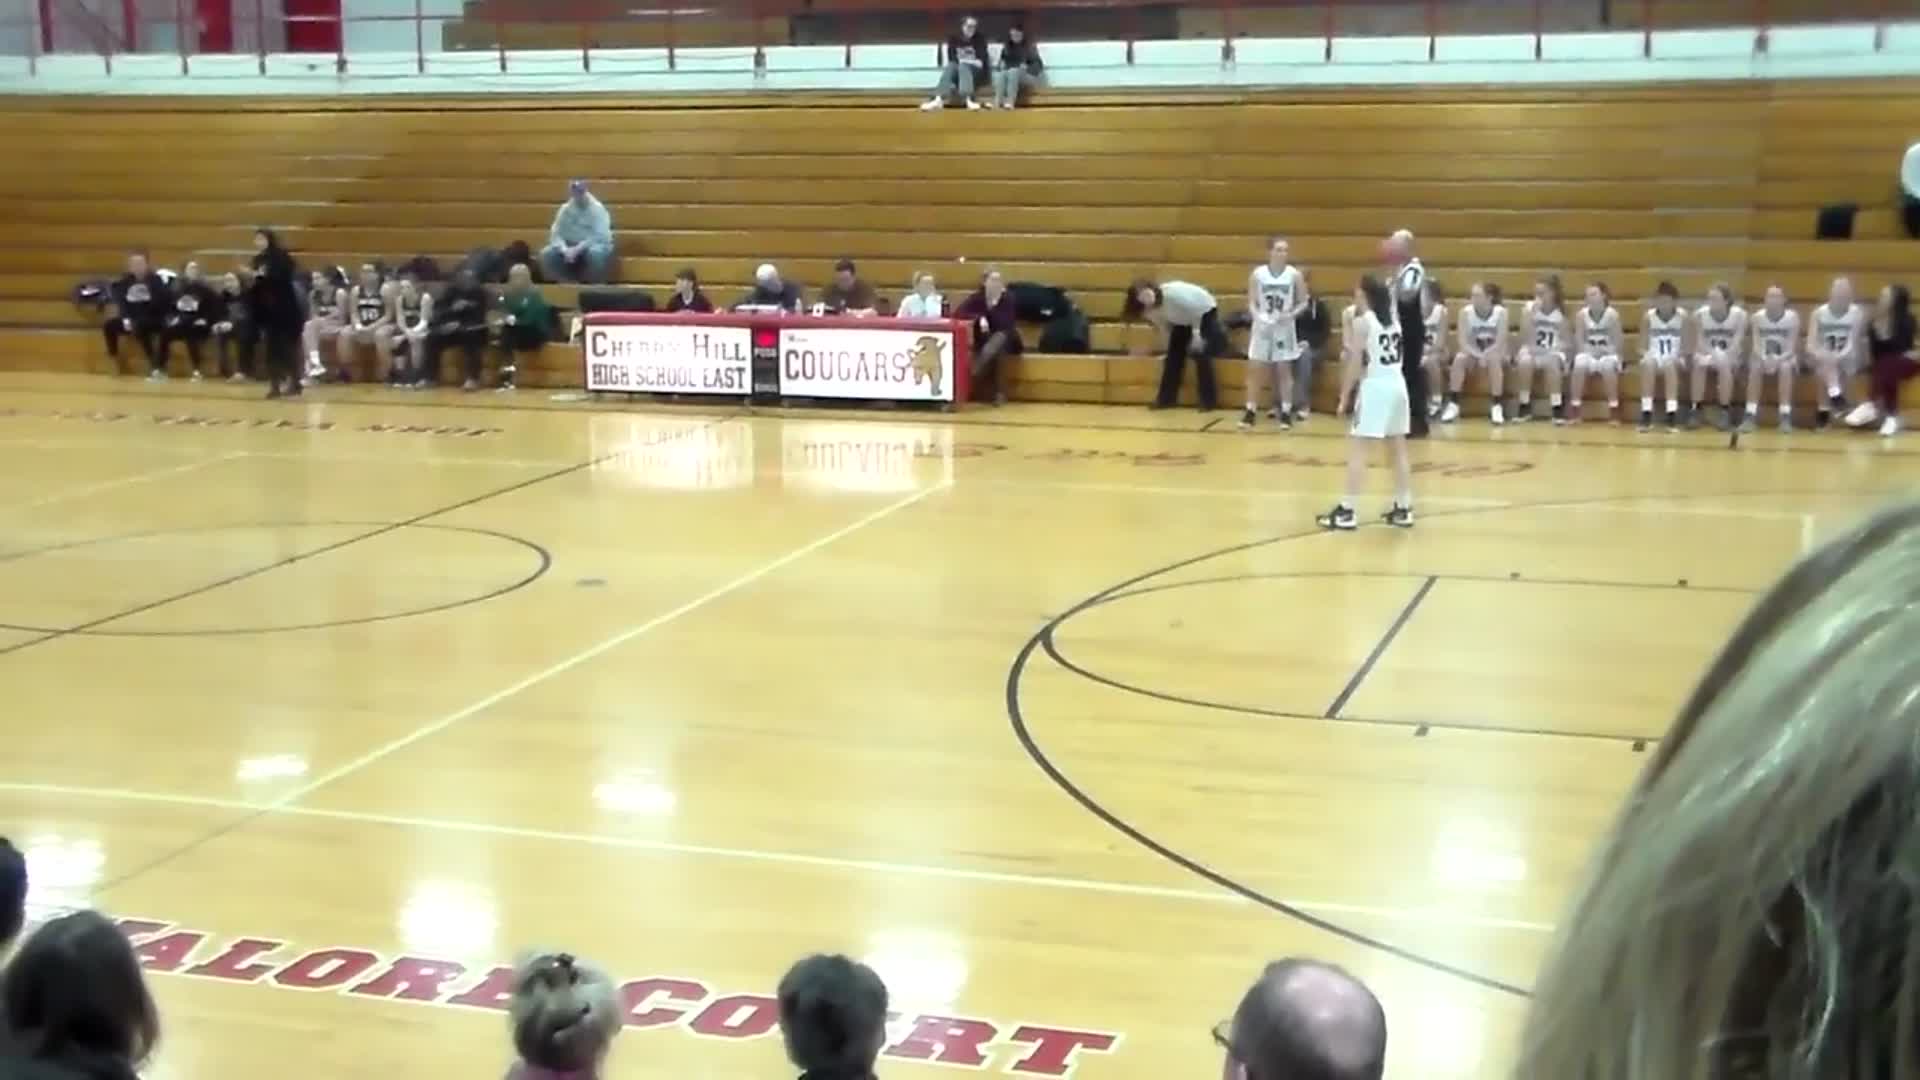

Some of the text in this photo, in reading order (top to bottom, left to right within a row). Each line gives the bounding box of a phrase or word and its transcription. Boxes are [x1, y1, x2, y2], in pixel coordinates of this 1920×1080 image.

[692, 332, 747, 362] HILL
[591, 362, 748, 390] HIGH SCHOOL EAST
[784, 349, 907, 383] COUGARS
[617, 977, 1118, 1077] CORT
